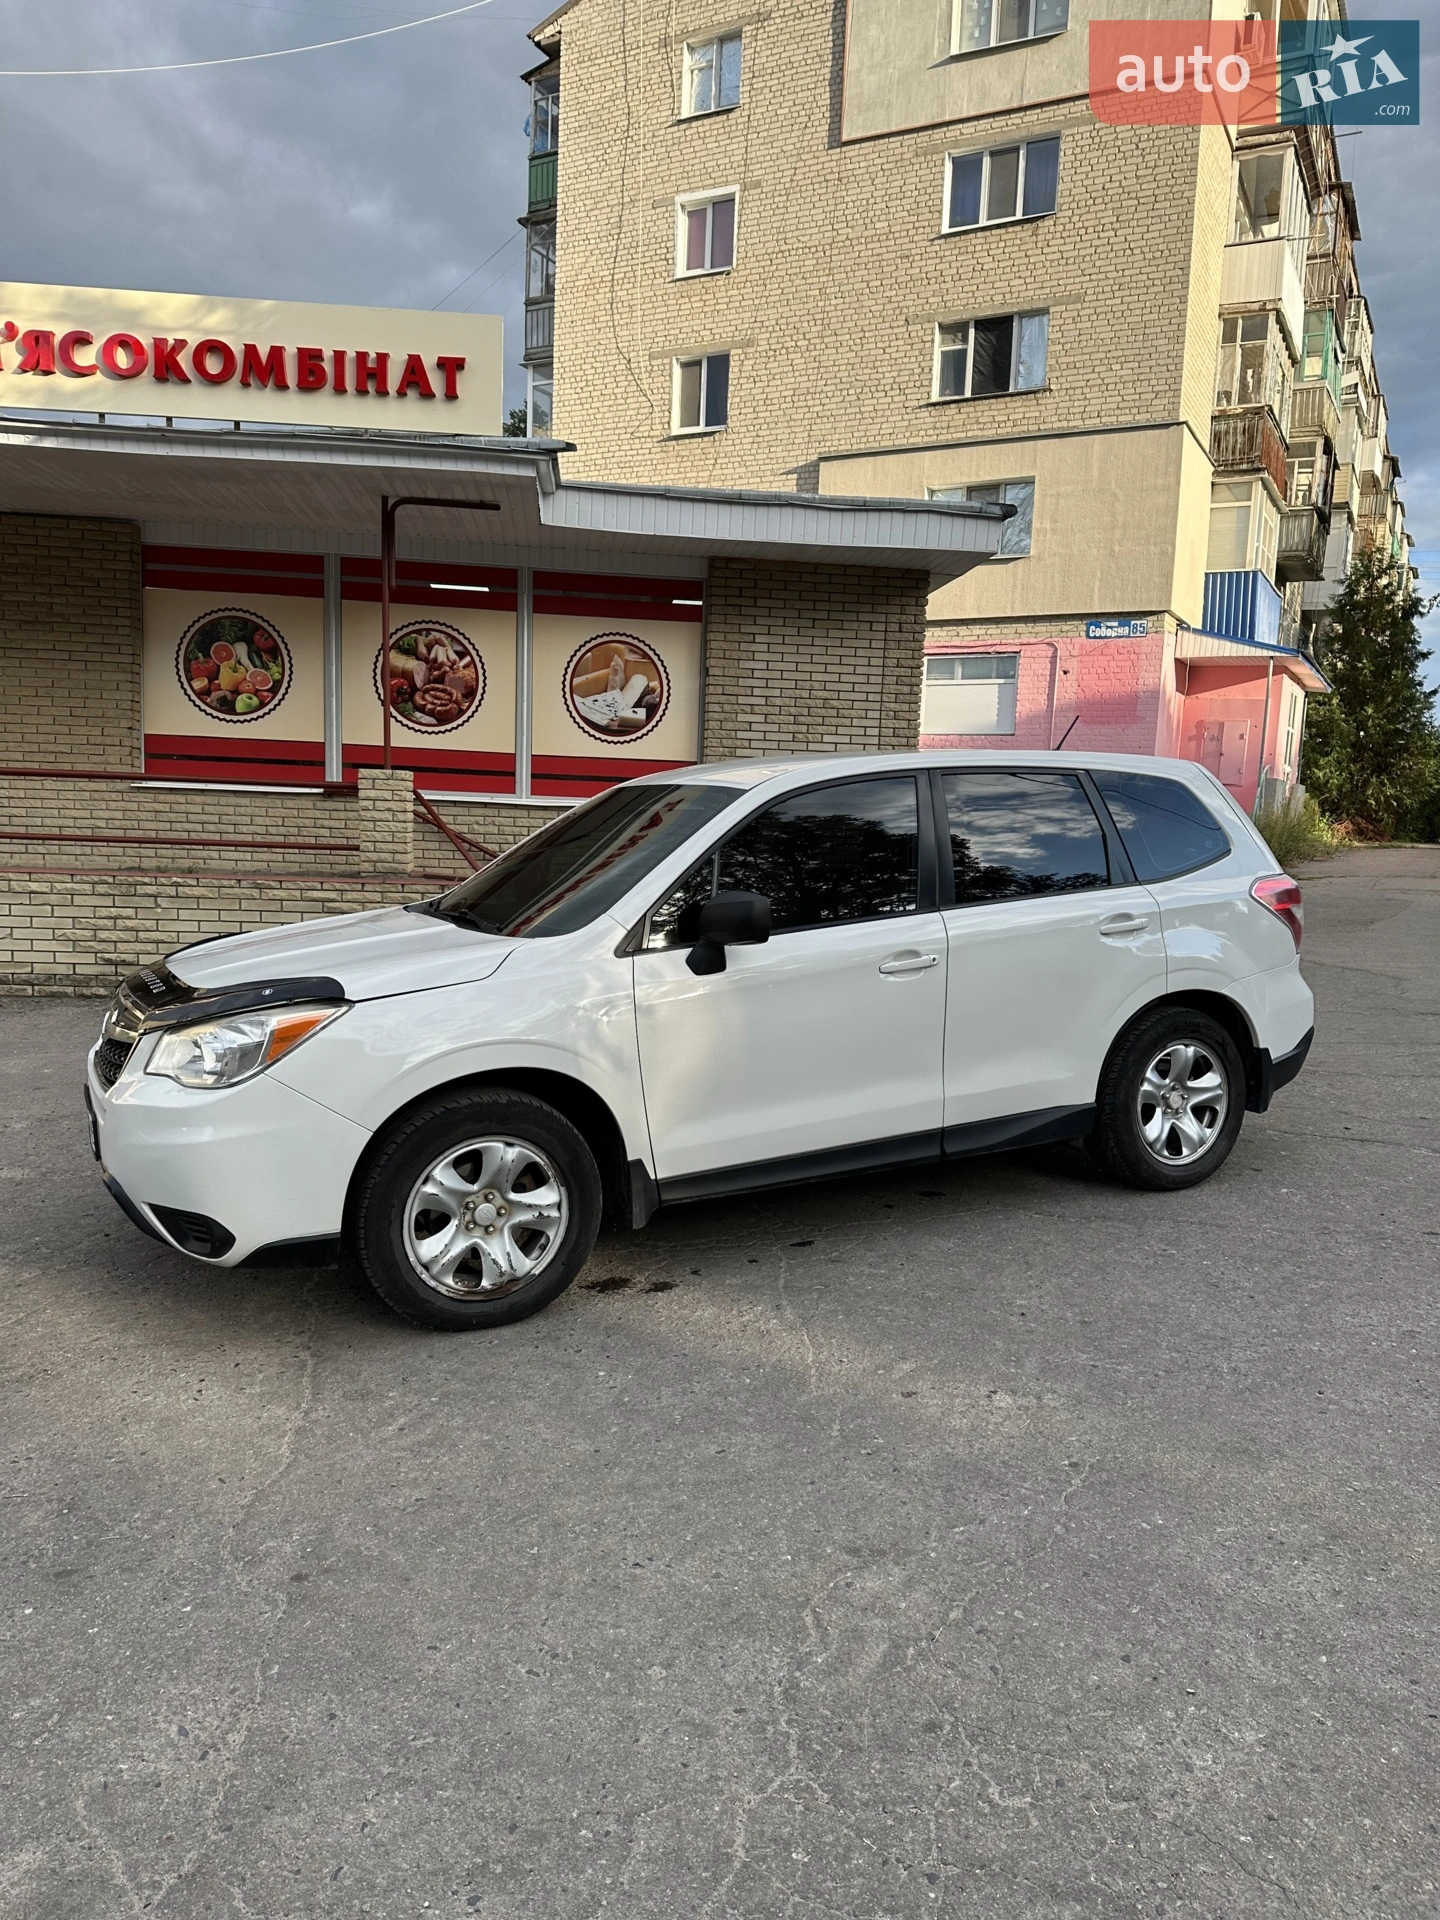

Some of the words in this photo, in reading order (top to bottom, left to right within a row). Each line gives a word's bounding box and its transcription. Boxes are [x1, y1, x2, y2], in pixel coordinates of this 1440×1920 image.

[0, 320, 466, 400] 'ЯСОКОМБІНАТ
[1089, 626, 1129, 637] Соборна
[1131, 622, 1146, 635] 85
